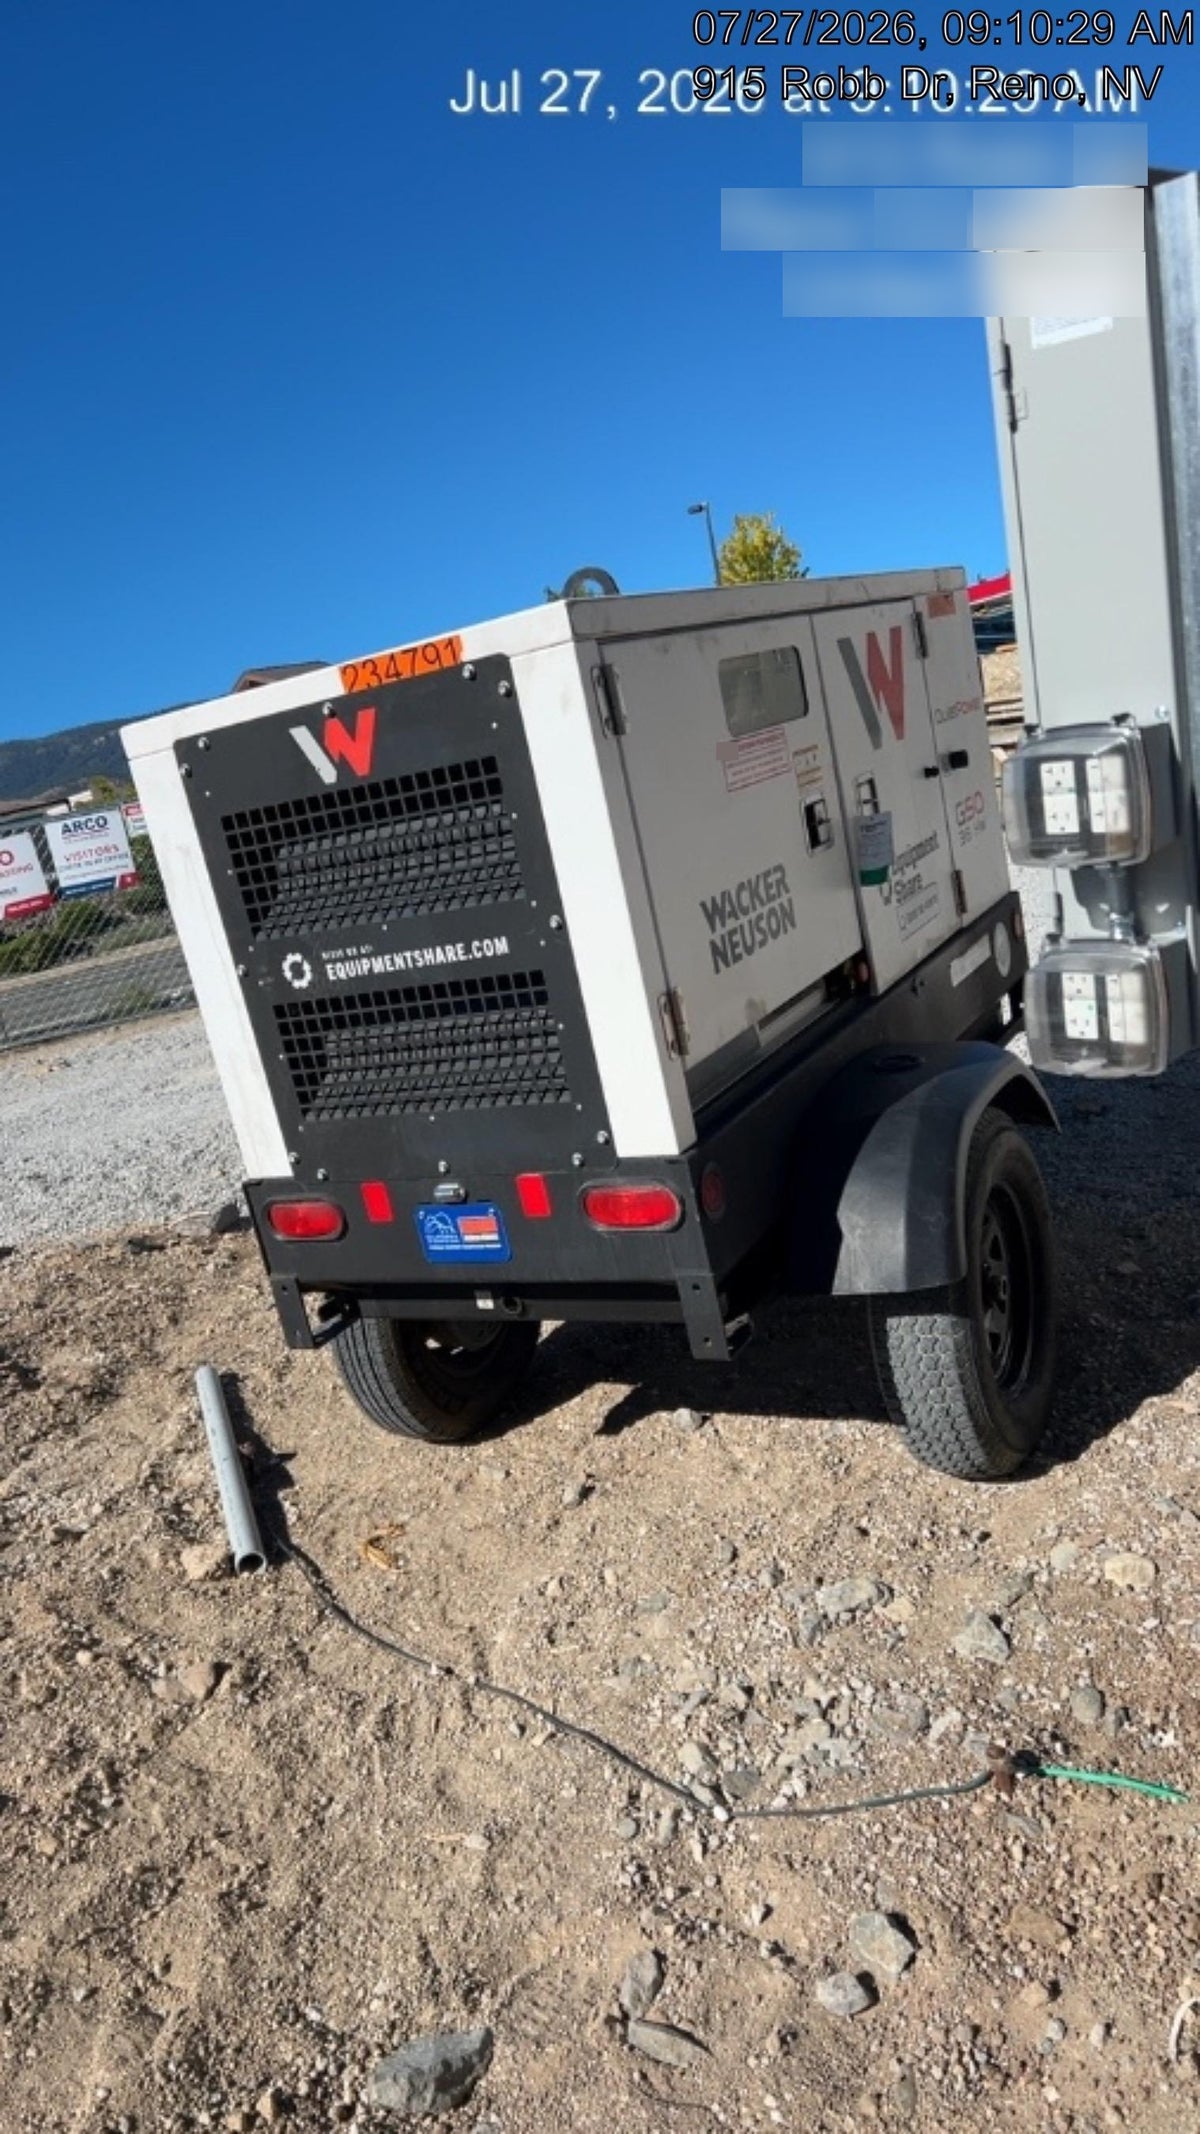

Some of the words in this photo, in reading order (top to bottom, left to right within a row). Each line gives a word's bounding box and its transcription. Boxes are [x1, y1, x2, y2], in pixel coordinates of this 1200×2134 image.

[341, 637, 459, 693] 234791
[61, 815, 108, 835] ARCO
[63, 844, 119, 864] VISITORS
[699, 863, 790, 933] WACKER
[325, 936, 509, 981] EQUIPMENTSHARE.COM
[709, 899, 797, 974] NEUSON
